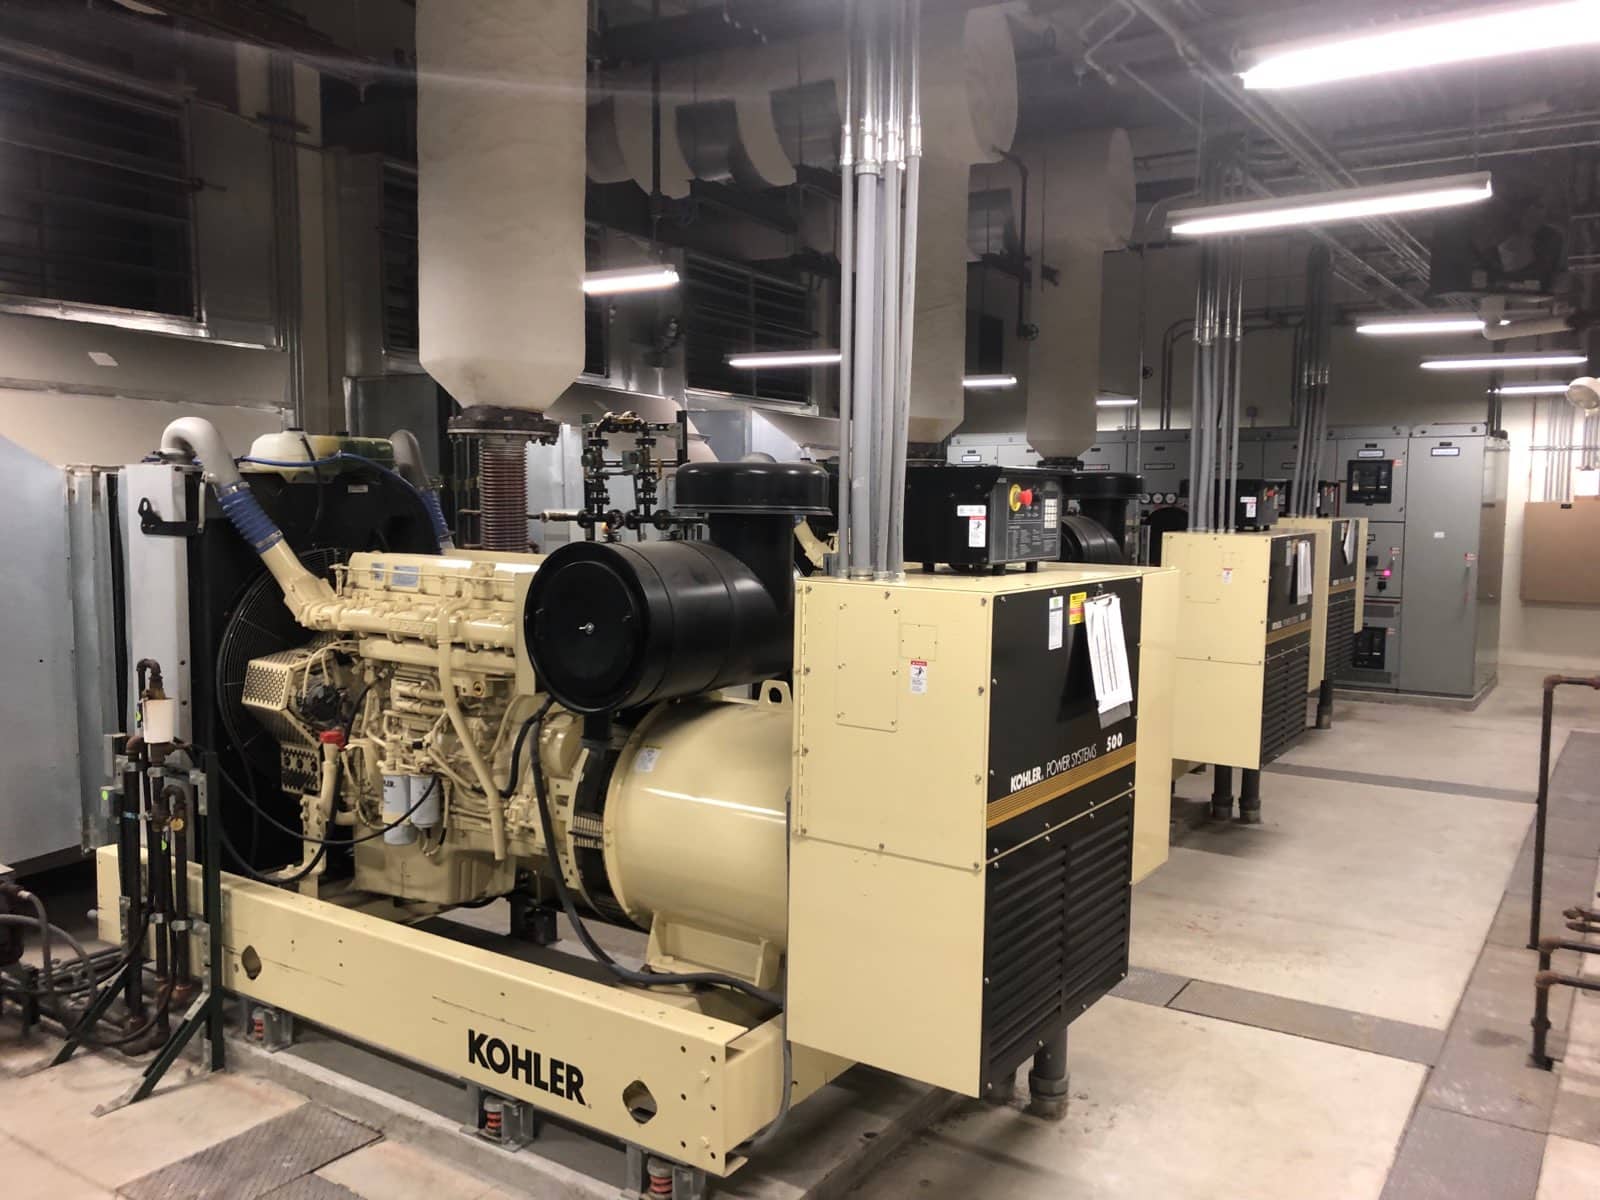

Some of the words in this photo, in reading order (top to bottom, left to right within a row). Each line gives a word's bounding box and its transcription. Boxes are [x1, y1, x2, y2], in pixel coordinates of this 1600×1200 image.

[1010, 766, 1042, 793] KOHLER
[1046, 754, 1070, 778] POWER
[1071, 743, 1097, 768] SYSTEMS
[1106, 732, 1123, 752] 500
[468, 1028, 586, 1106] KOHLER
